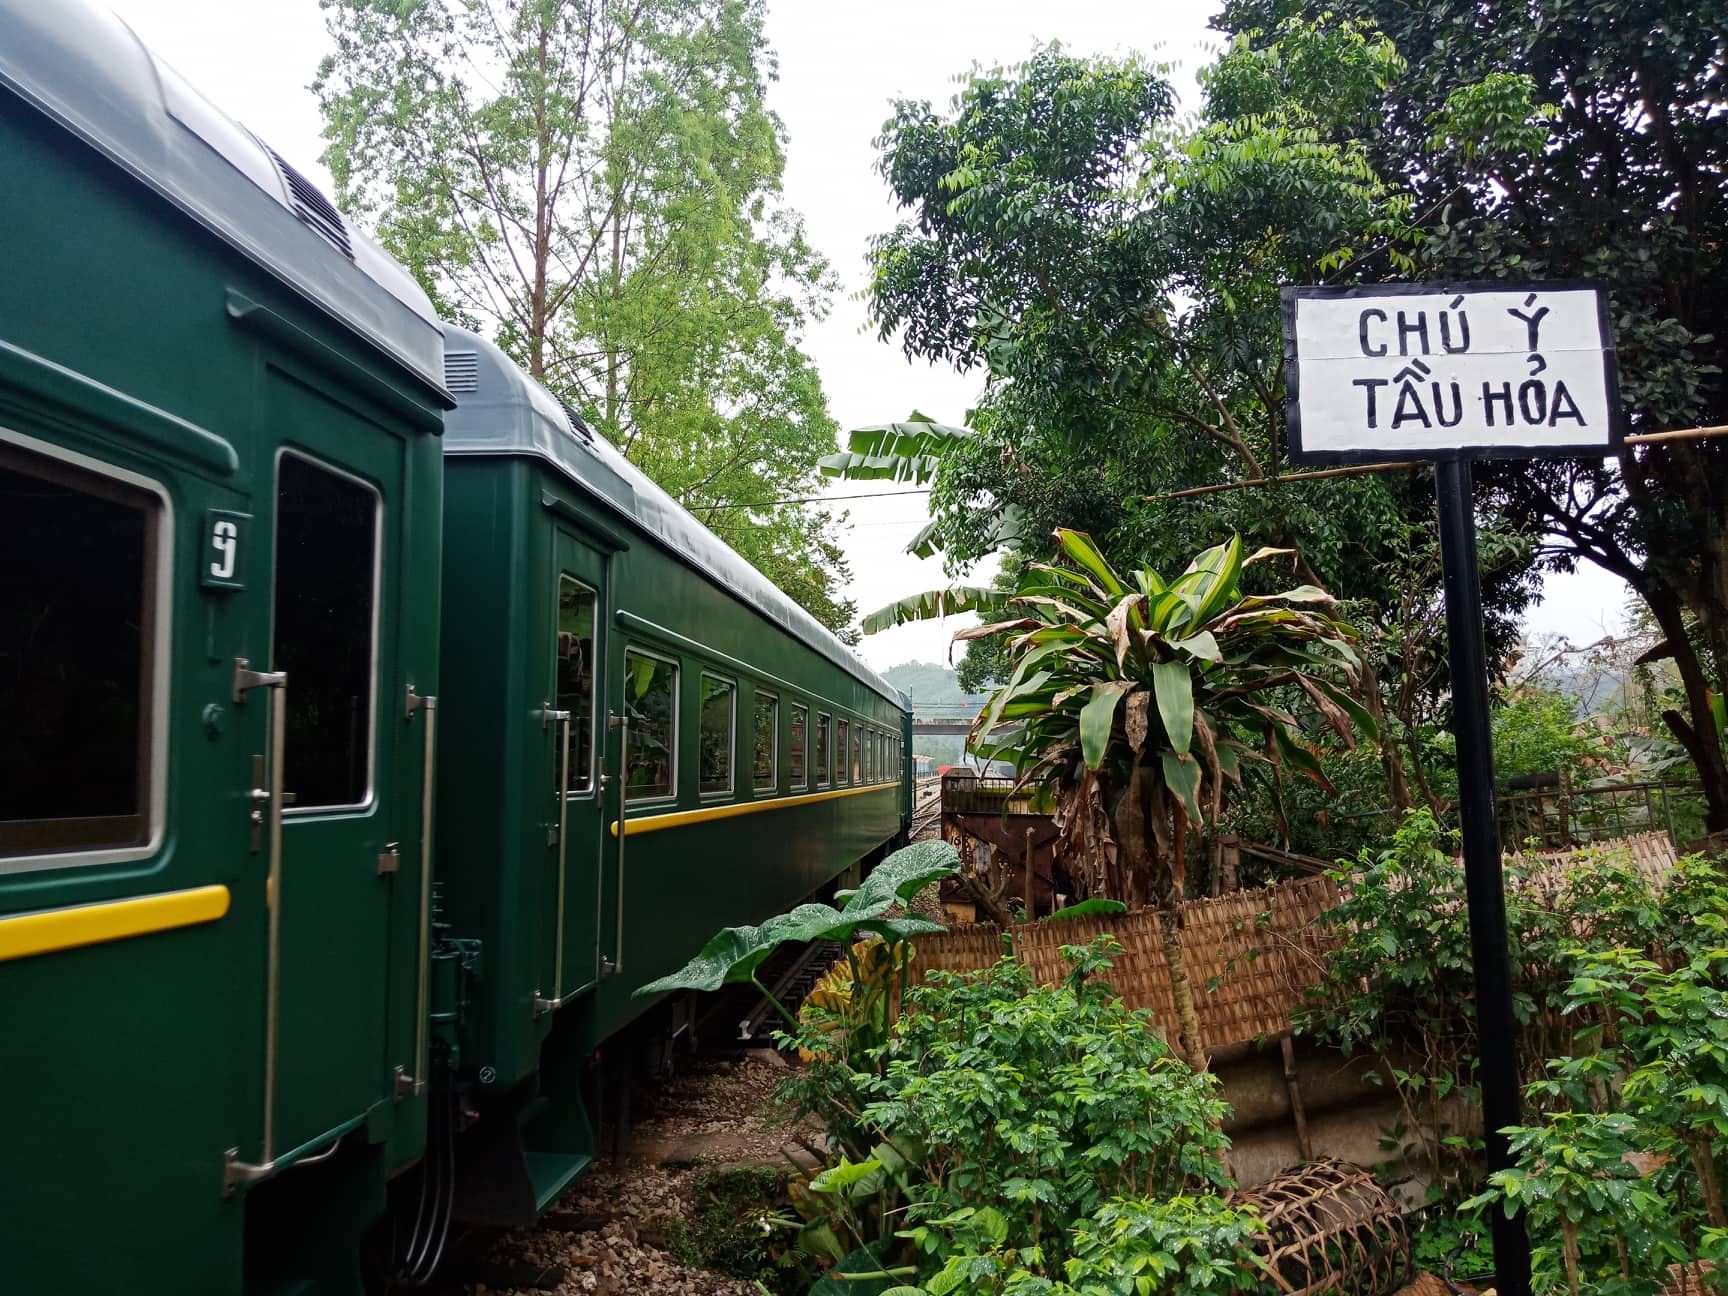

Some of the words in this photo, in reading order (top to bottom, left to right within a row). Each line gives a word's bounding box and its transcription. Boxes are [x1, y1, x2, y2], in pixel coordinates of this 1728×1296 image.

[1359, 294, 1471, 358] CHÚ
[1507, 293, 1550, 352] Ý
[1352, 358, 1466, 430] TẦU
[1478, 353, 1588, 428] HỎA
[210, 520, 238, 578] 9
